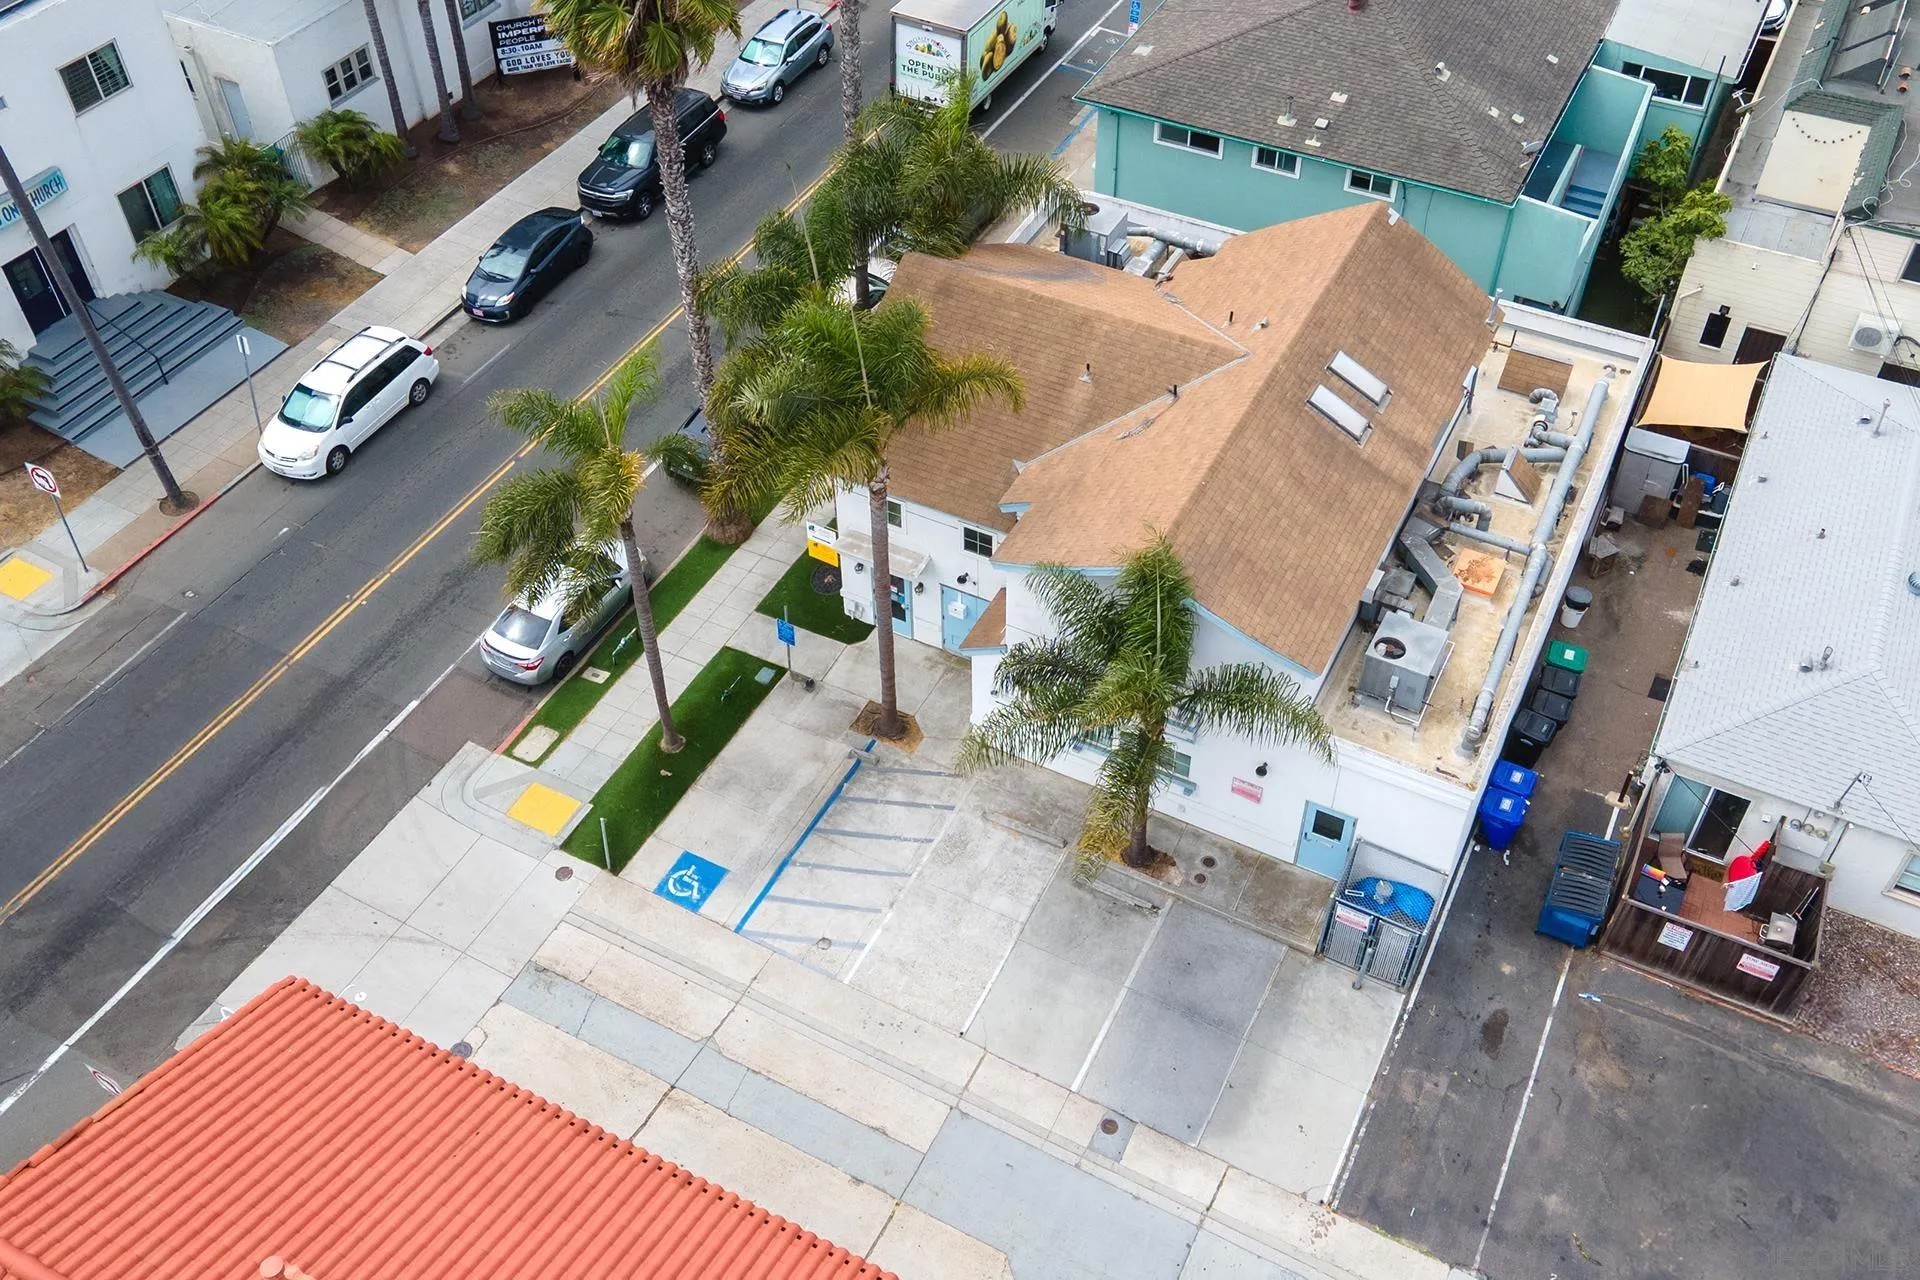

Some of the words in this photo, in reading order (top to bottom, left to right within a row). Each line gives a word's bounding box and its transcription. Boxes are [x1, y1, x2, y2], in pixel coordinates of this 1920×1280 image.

[496, 20, 535, 31] CHURCH
[498, 24, 551, 38] IMPERFE
[500, 35, 535, 45] PEOPLE
[506, 59, 522, 67] GOD
[525, 54, 551, 63] LOVES
[555, 51, 571, 59] YOU
[908, 59, 933, 71] OPEN
[936, 66, 949, 75] TO
[902, 64, 919, 75] THE
[922, 70, 949, 81] PUBLI
[27, 175, 64, 207] HURCH
